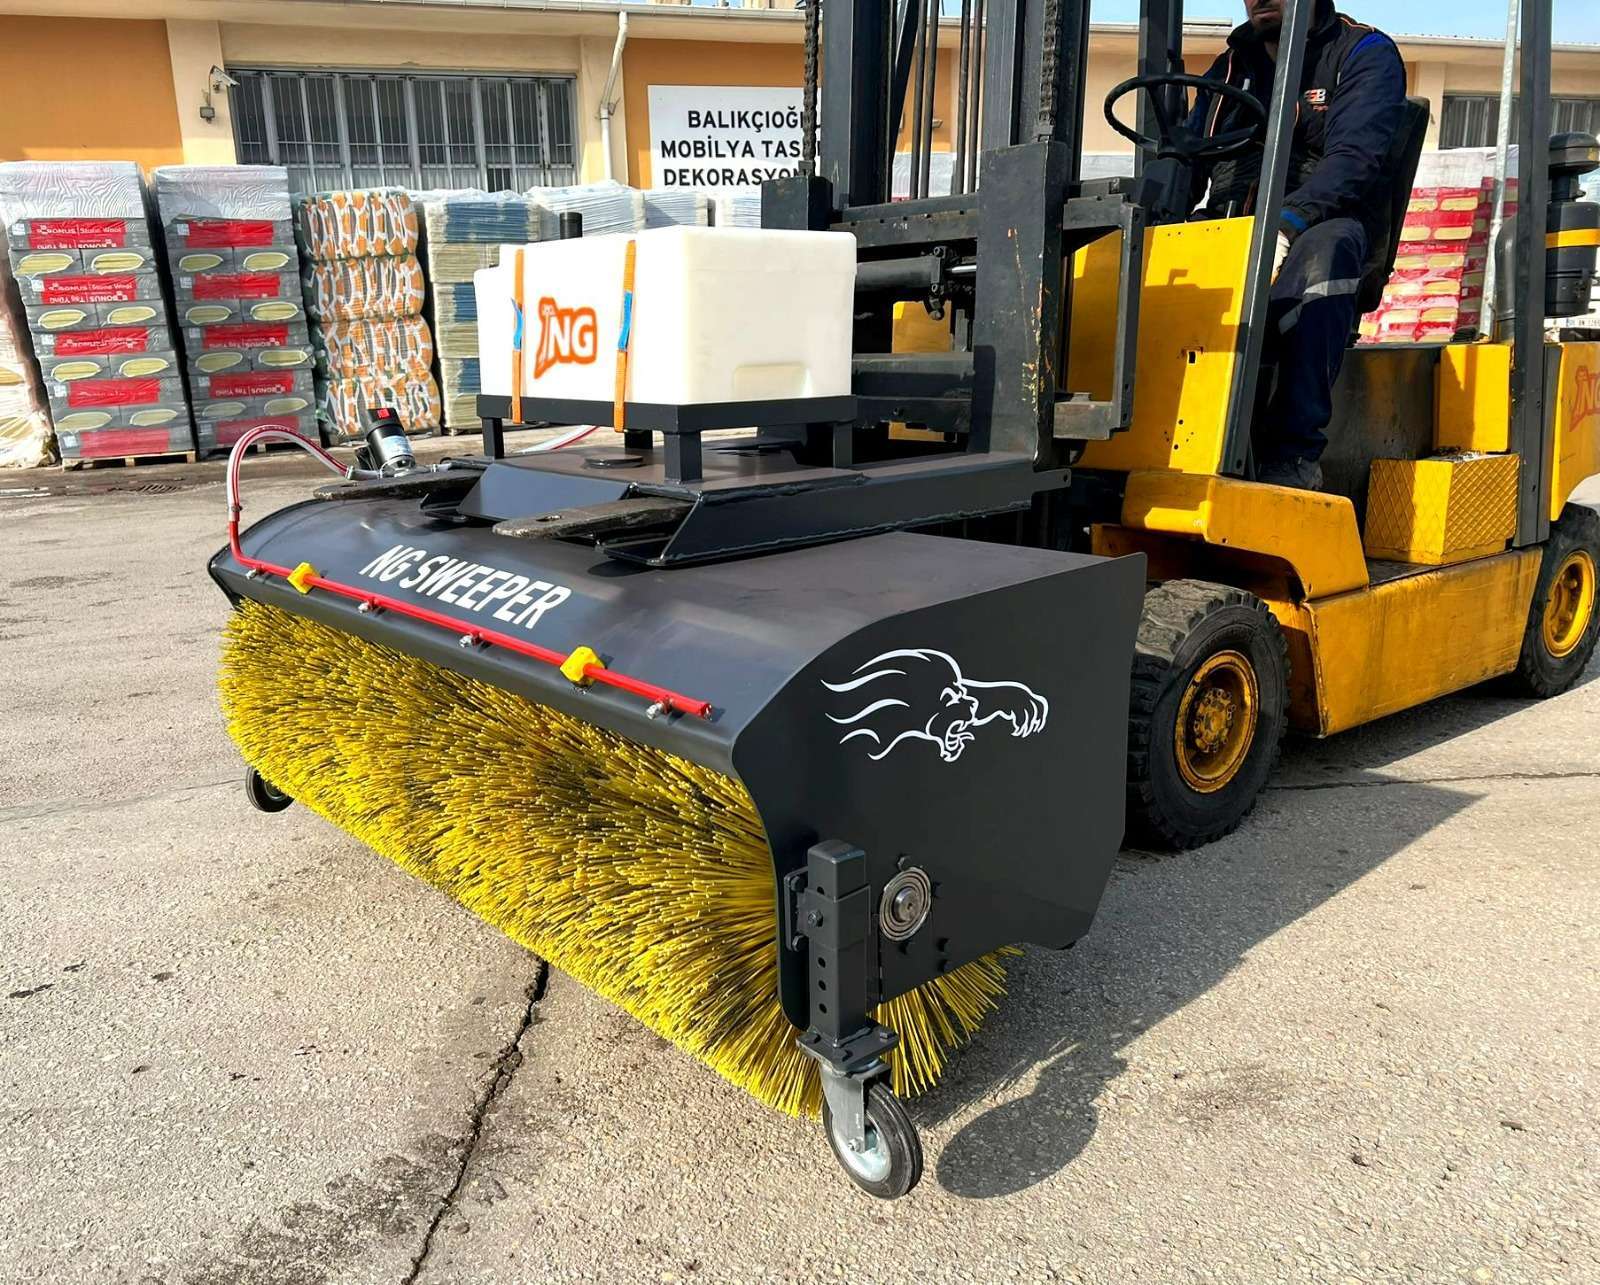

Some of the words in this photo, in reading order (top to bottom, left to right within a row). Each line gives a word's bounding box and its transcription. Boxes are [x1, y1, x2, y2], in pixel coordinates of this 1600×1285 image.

[688, 106, 820, 132] BALIKÇIOĞ
[661, 135, 755, 158] MOBİLYA
[761, 140, 821, 158] TAS
[358, 544, 428, 582] NG
[399, 555, 573, 630] SWEEPER
